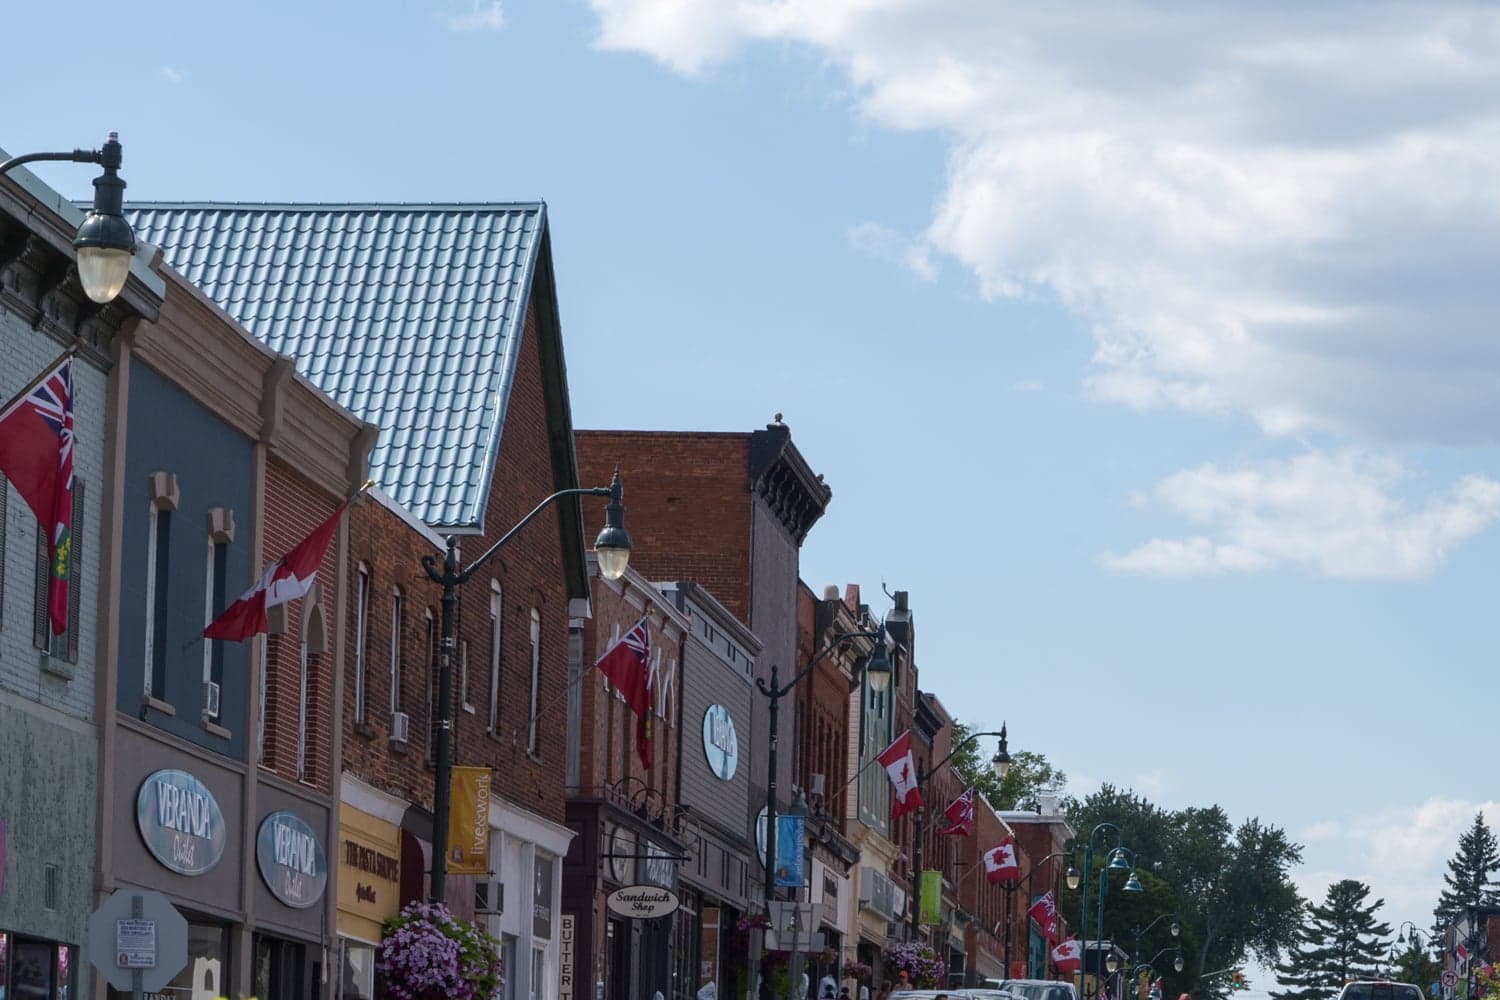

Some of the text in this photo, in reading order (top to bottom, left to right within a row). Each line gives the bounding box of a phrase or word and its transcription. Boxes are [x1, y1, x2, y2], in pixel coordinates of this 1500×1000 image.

[155, 779, 212, 840] VERANDA
[471, 774, 490, 855] live&work
[272, 820, 316, 877] VERANDA
[616, 891, 670, 904] Sandwich
[632, 902, 655, 913] Shop
[562, 918, 572, 986] BUTTER
